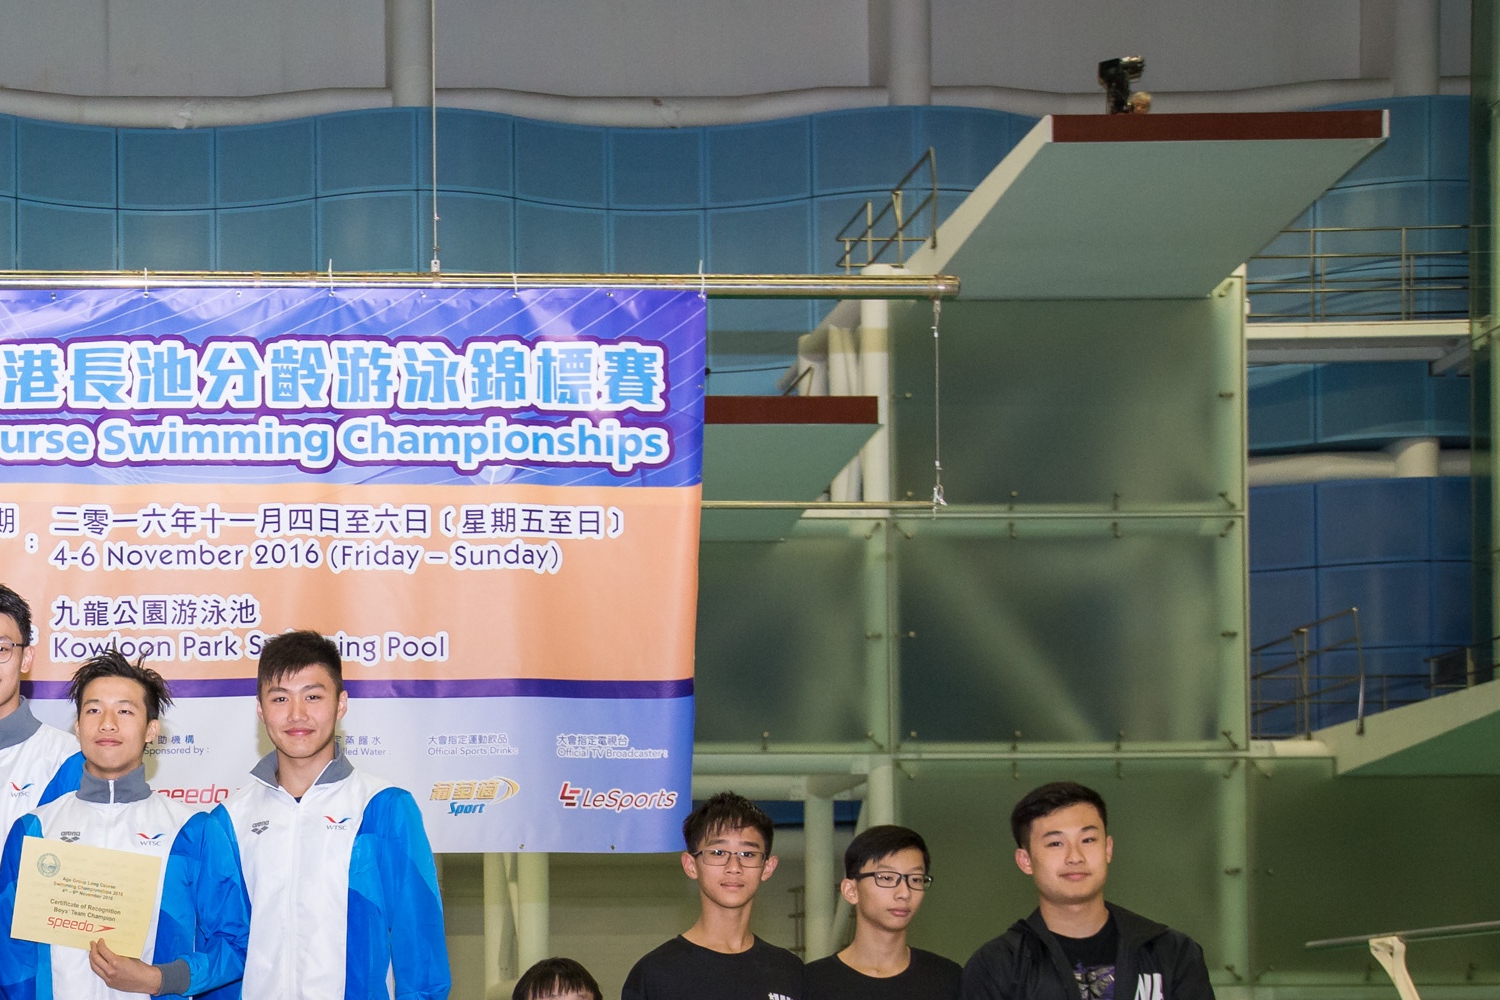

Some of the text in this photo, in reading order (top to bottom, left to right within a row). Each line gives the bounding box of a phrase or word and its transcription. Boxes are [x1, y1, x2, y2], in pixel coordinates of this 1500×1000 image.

[103, 422, 329, 462] Swimming
[342, 422, 664, 466] Championships
[53, 545, 96, 566] 4-6
[107, 544, 245, 566] November
[254, 544, 319, 565] 2016
[330, 544, 420, 570] (Friday
[454, 543, 560, 570] Sunday)
[54, 598, 258, 627] 九龍公園游泳池
[53, 636, 171, 658] Kowloon
[183, 635, 238, 657] Park
[387, 636, 445, 658] Pool
[145, 734, 195, 745] 助機構
[144, 745, 191, 757] Sponsored
[360, 747, 386, 756] Water
[427, 746, 458, 756] Official
[459, 746, 488, 757] Sports
[557, 747, 590, 758] Official
[591, 747, 605, 758] TV
[582, 788, 678, 812] LeSports
[446, 801, 486, 817] Sport
[251, 820, 270, 828] arena
[50, 898, 80, 908] Certificate
[87, 904, 122, 915] Recognition
[46, 916, 96, 933] speedo
[86, 911, 117, 922] Champion
